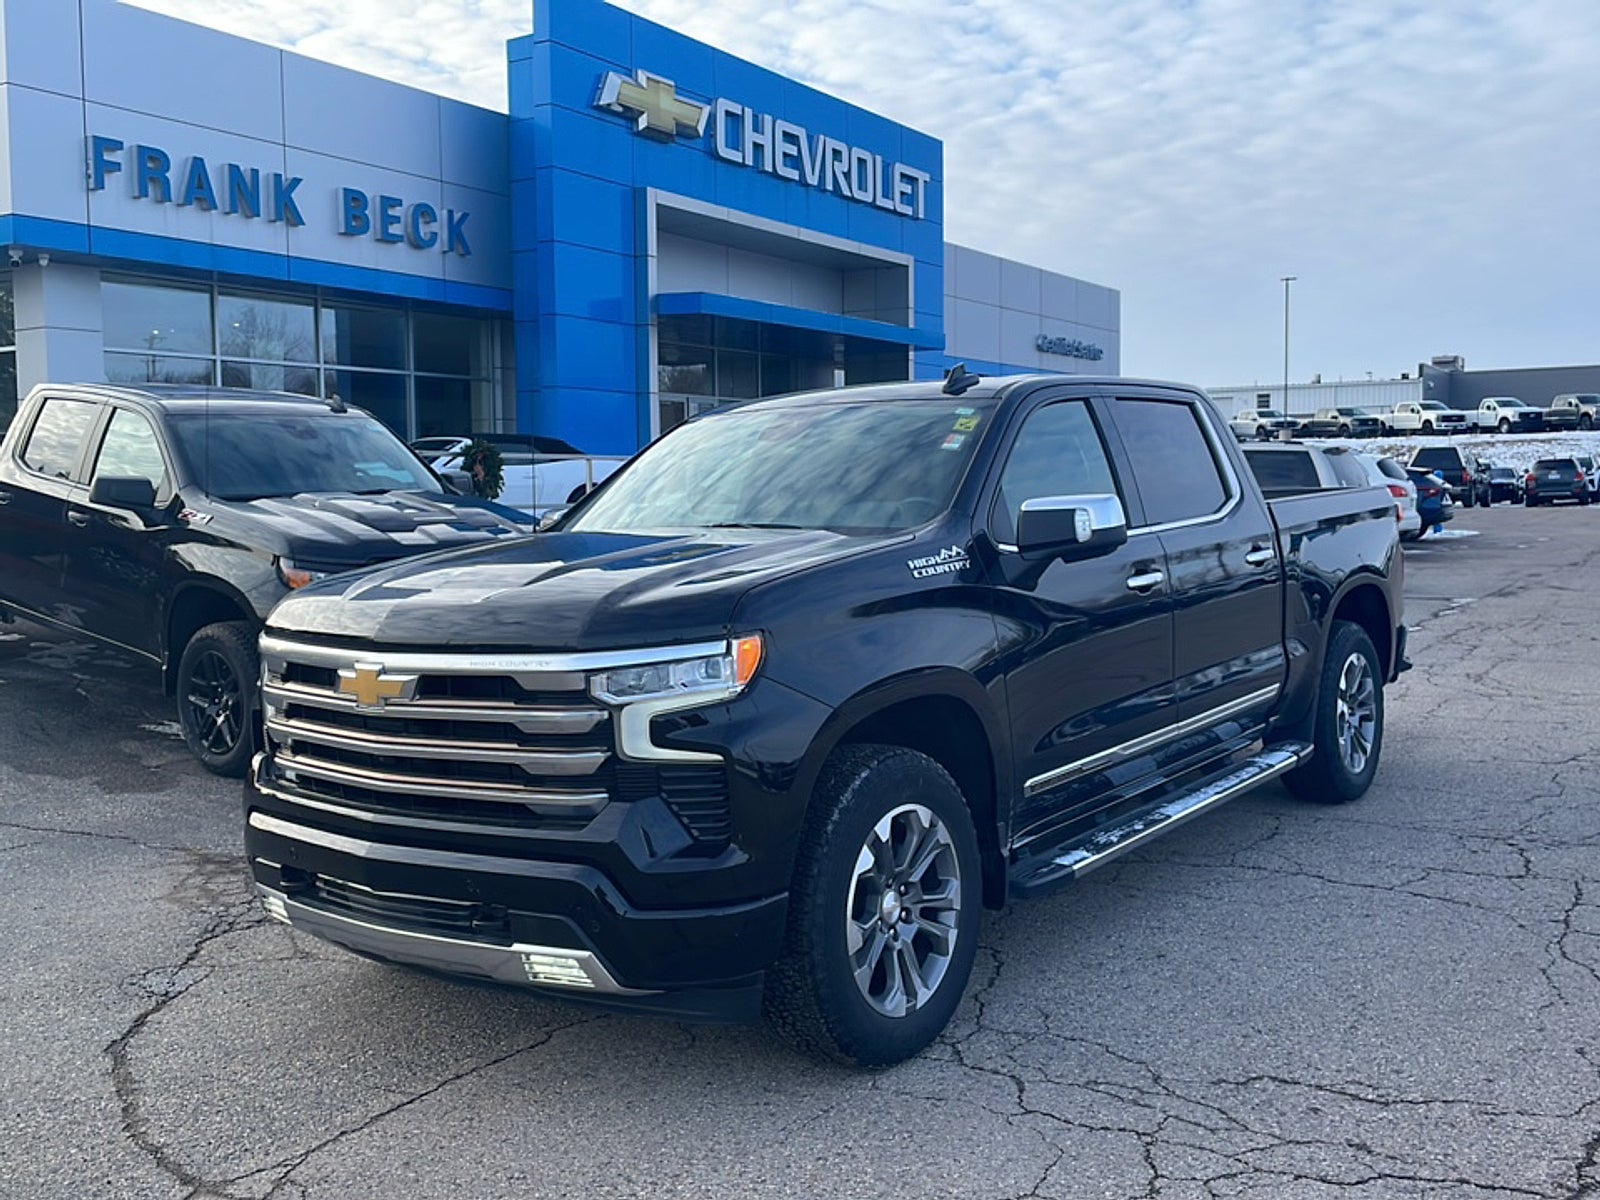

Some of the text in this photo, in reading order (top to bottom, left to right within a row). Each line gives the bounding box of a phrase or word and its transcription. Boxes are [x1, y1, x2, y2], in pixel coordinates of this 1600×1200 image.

[715, 97, 931, 219] CHEVROLET
[87, 135, 472, 256] FRANK BECK
[907, 555, 942, 570] HIGH
[912, 559, 970, 578] COUNTRY
